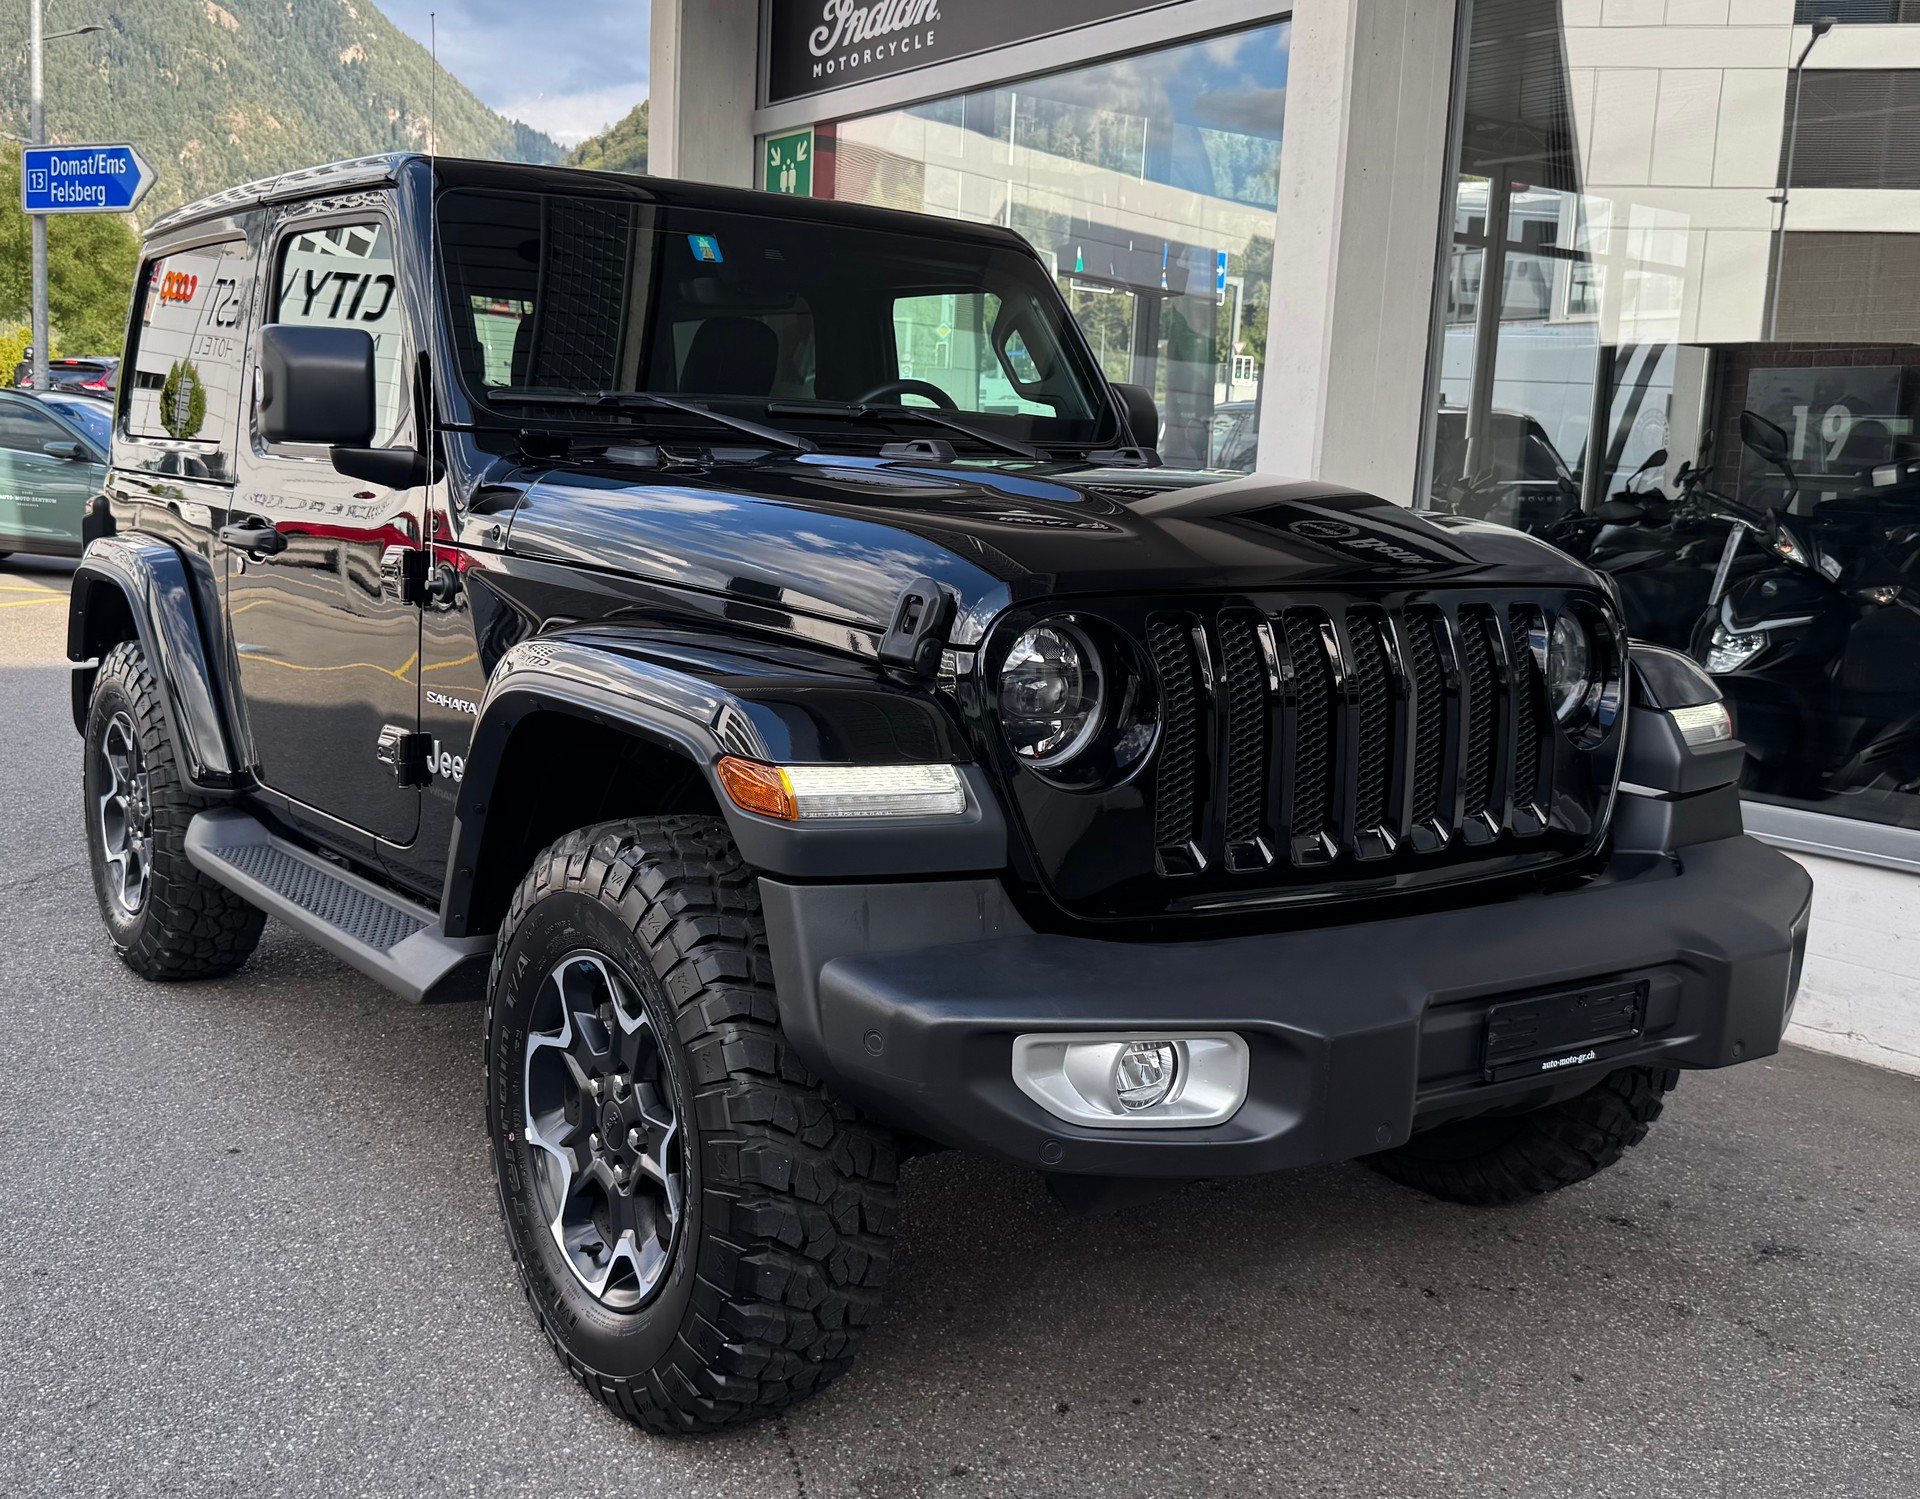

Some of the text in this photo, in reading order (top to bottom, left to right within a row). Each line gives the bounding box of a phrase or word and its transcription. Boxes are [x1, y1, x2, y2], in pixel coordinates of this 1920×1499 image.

[808, 0, 938, 57] Indian
[812, 30, 936, 79] MOTORCYCLE
[50, 153, 126, 177] Domat/Ems
[31, 172, 44, 189] 13
[50, 180, 106, 206] Felsberg
[1791, 403, 1852, 462] 19
[426, 690, 478, 716] SAHARA
[426, 739, 466, 783] Jee
[1541, 1049, 1597, 1071] auto-moto-gr.ch
